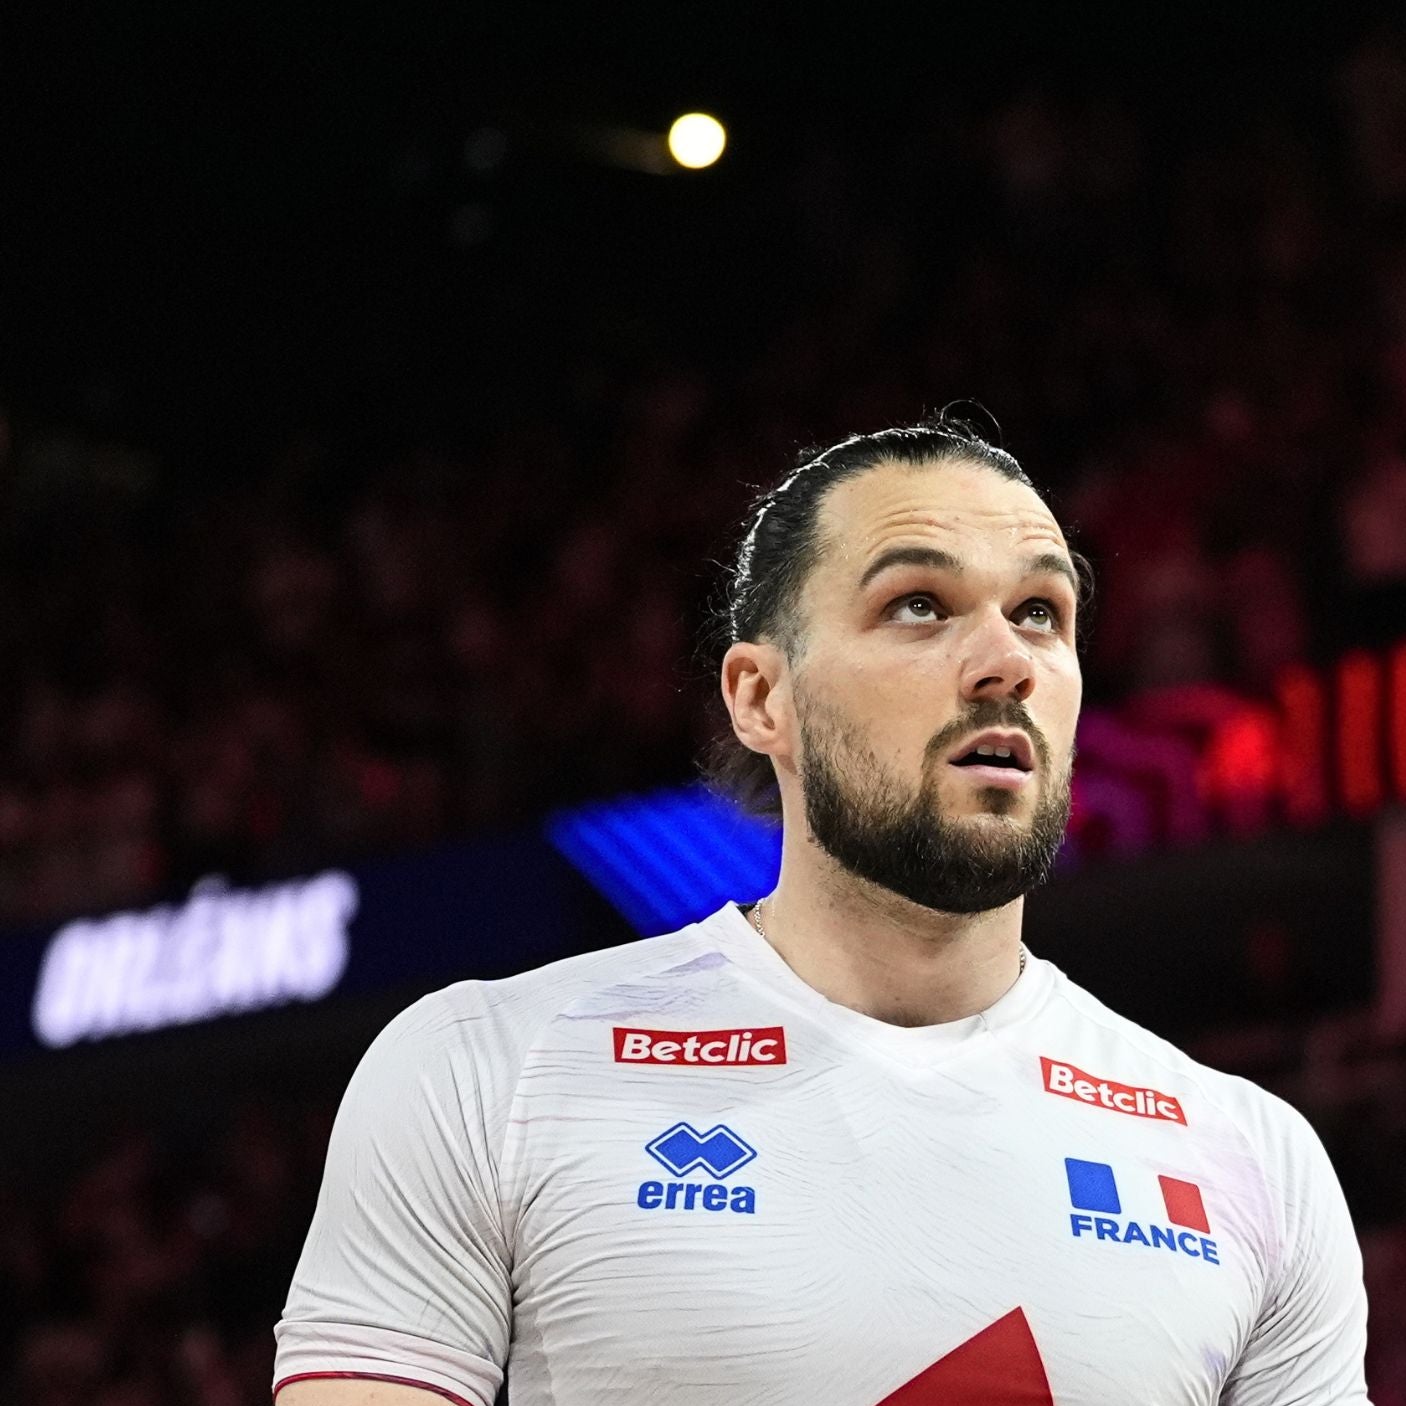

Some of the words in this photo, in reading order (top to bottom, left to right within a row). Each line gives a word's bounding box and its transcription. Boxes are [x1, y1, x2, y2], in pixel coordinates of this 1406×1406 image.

[621, 1031, 778, 1062] Betclic
[1050, 1064, 1179, 1119] Betclic
[1070, 1213, 1220, 1265] FRANCE
